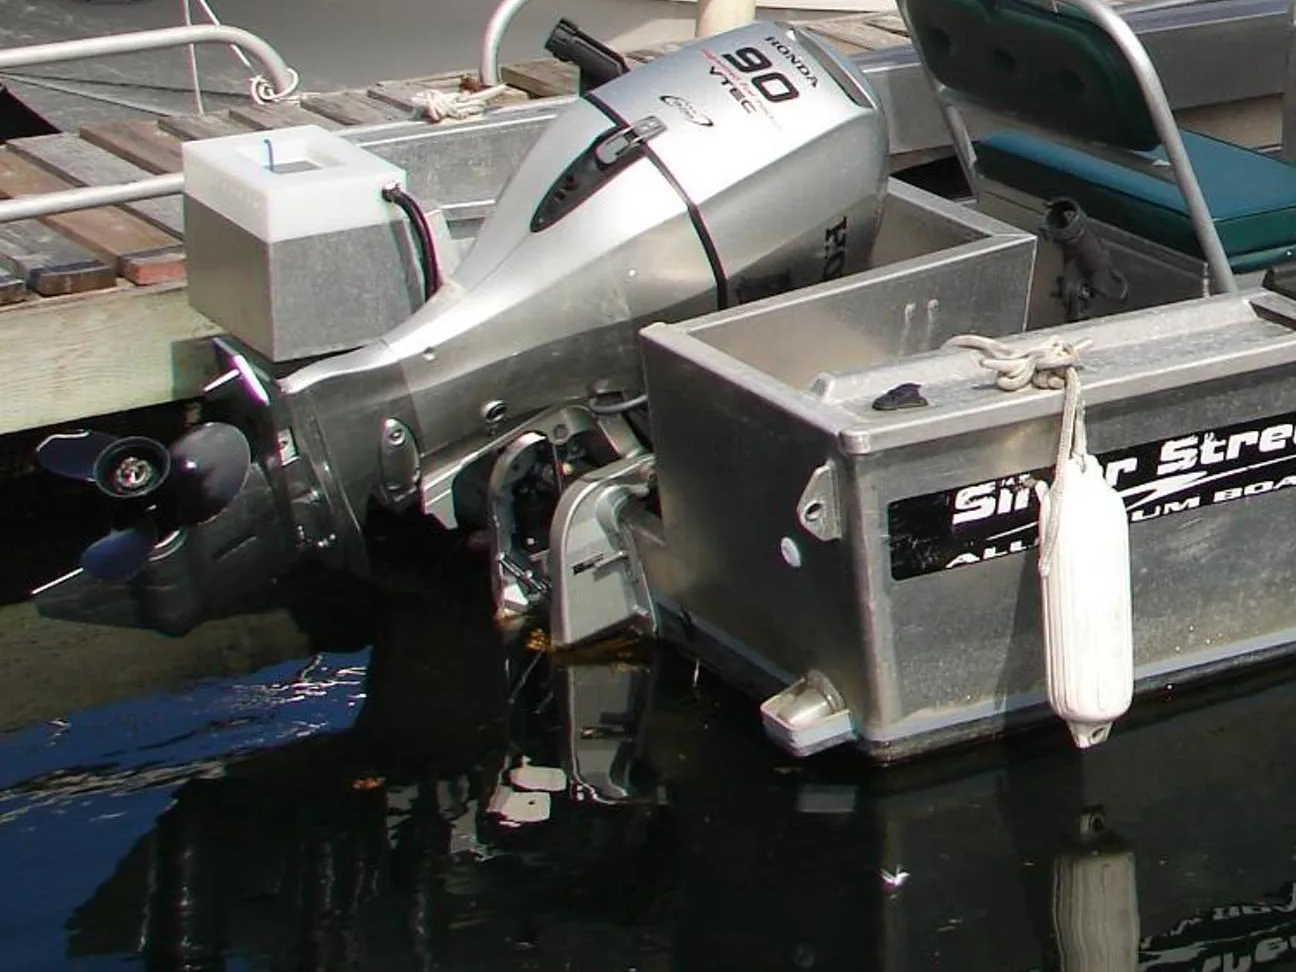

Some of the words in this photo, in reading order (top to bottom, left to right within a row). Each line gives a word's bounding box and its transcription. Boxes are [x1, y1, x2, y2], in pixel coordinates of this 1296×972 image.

[708, 65, 758, 115] VTEC
[721, 46, 800, 103] 90
[764, 35, 819, 88] HONDA
[952, 457, 1137, 525] Silr
[945, 496, 1200, 569] ALUUM
